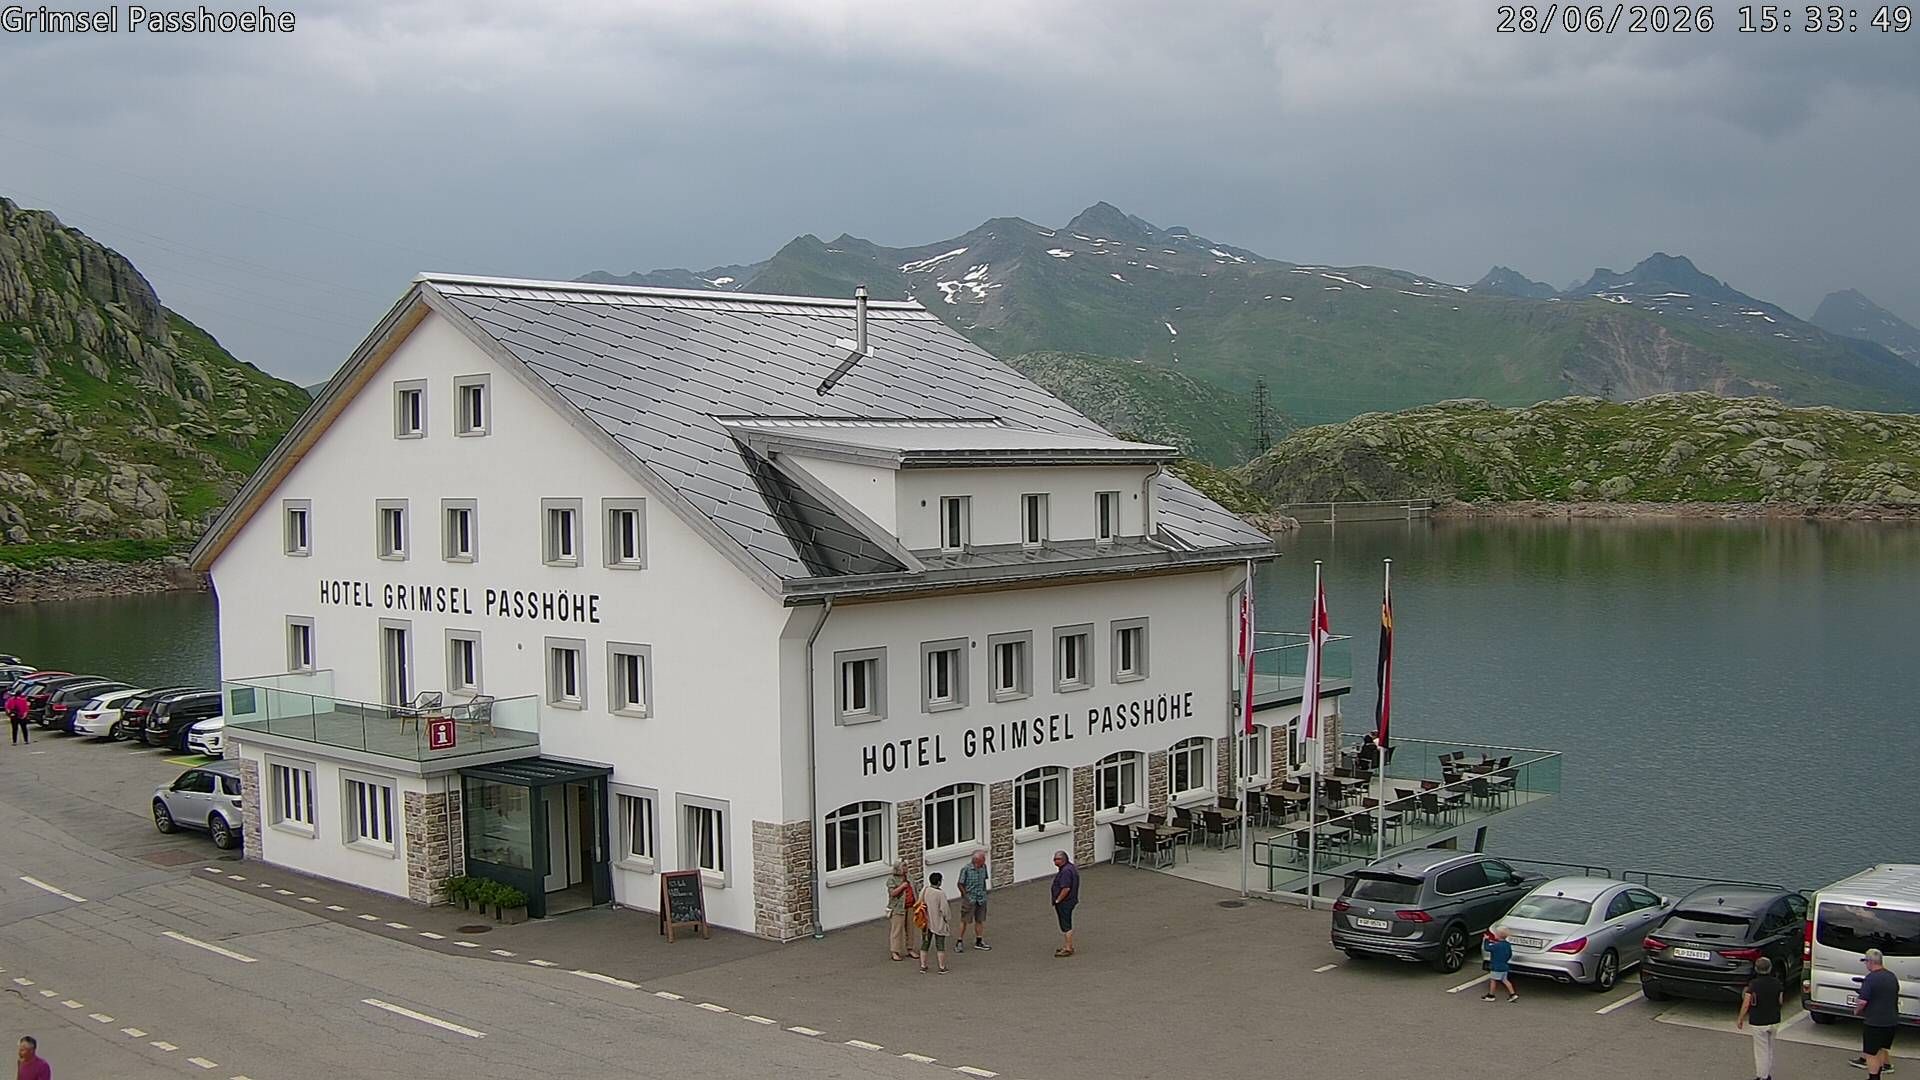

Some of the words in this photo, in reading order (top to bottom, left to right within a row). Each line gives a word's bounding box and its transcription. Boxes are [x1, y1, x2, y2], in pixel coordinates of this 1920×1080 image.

[320, 580, 373, 608] HOTEL
[384, 584, 473, 615] GRIMSEL
[486, 589, 600, 623] PASSHÖHE
[863, 735, 946, 776] HOTEL
[964, 714, 1074, 758] GRIMSEL
[1088, 691, 1193, 736] PASSHÖHE
